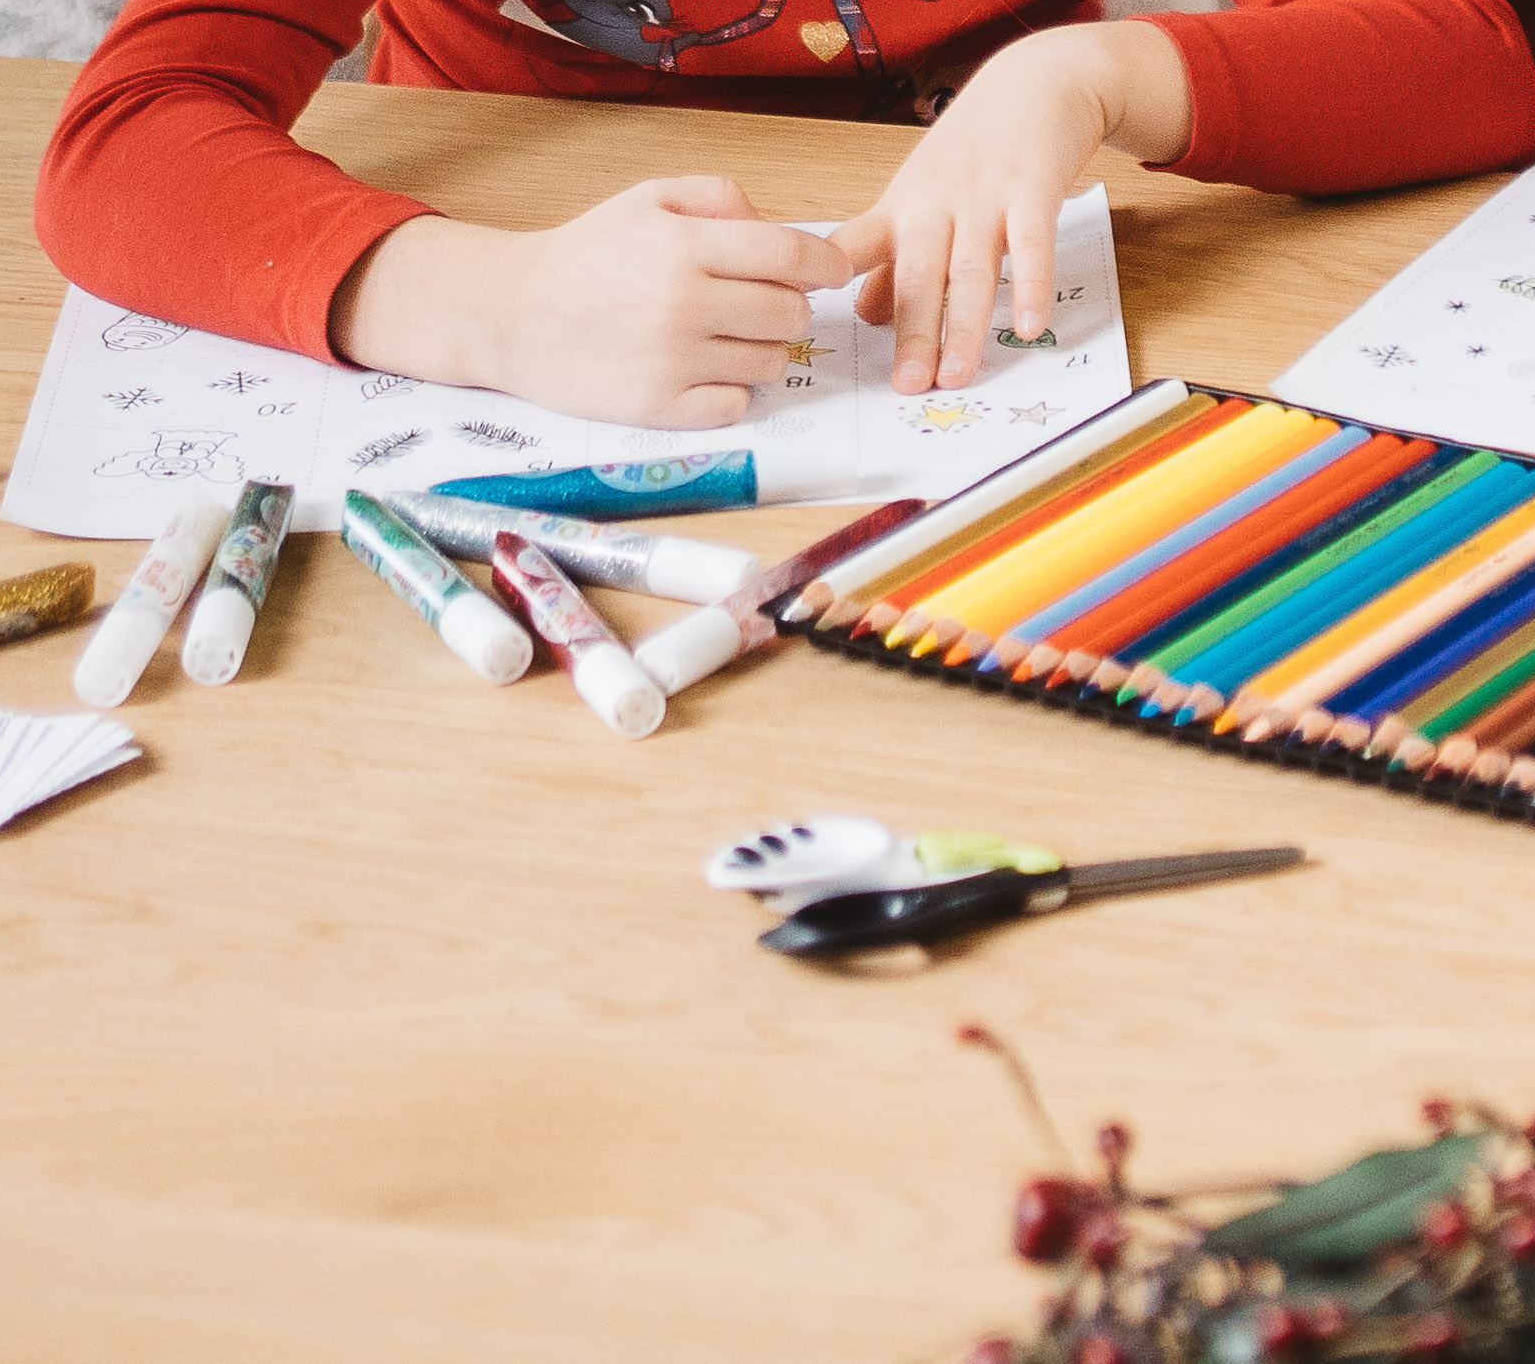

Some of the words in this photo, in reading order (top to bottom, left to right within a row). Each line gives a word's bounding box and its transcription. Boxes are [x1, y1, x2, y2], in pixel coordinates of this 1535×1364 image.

[1056, 286, 1085, 303] 21
[785, 375, 814, 389] 18
[257, 402, 298, 417] 20
[601, 453, 712, 485] OLORS
